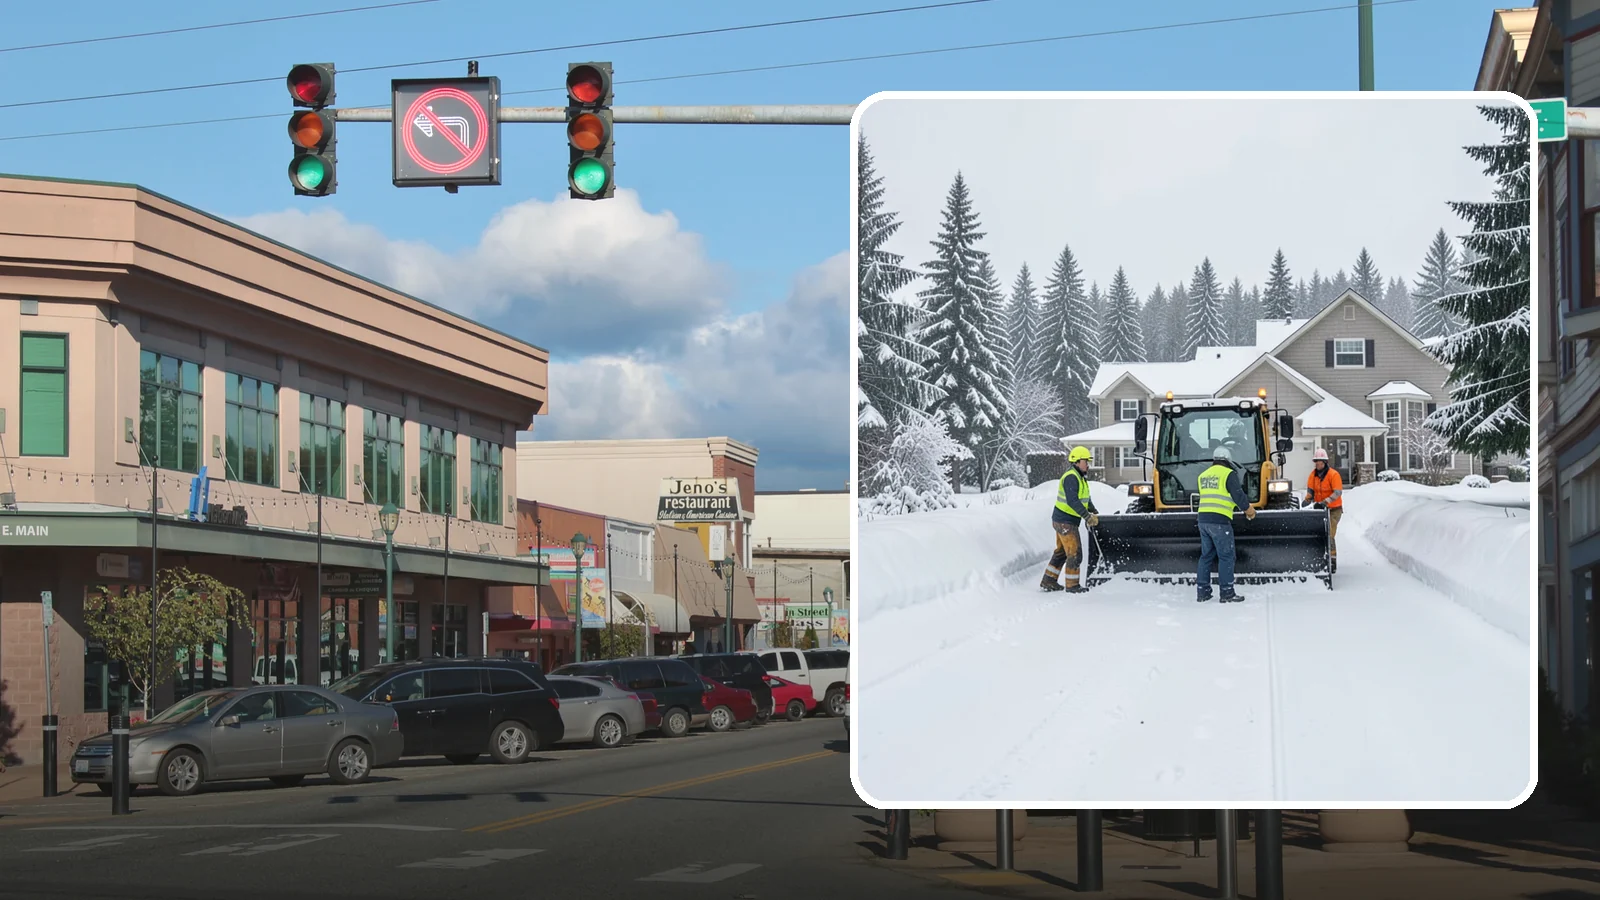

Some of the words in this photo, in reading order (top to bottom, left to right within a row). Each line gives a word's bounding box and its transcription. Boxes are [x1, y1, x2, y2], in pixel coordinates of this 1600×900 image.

[670, 480, 728, 494] Jeno's
[665, 496, 731, 509] restaurant
[658, 509, 682, 520] Italian
[686, 509, 714, 520] American
[715, 509, 737, 520] Cuisine
[2, 525, 13, 536] E.
[15, 525, 49, 537] MAIN
[797, 608, 828, 616] Street
[791, 619, 824, 627] lass
